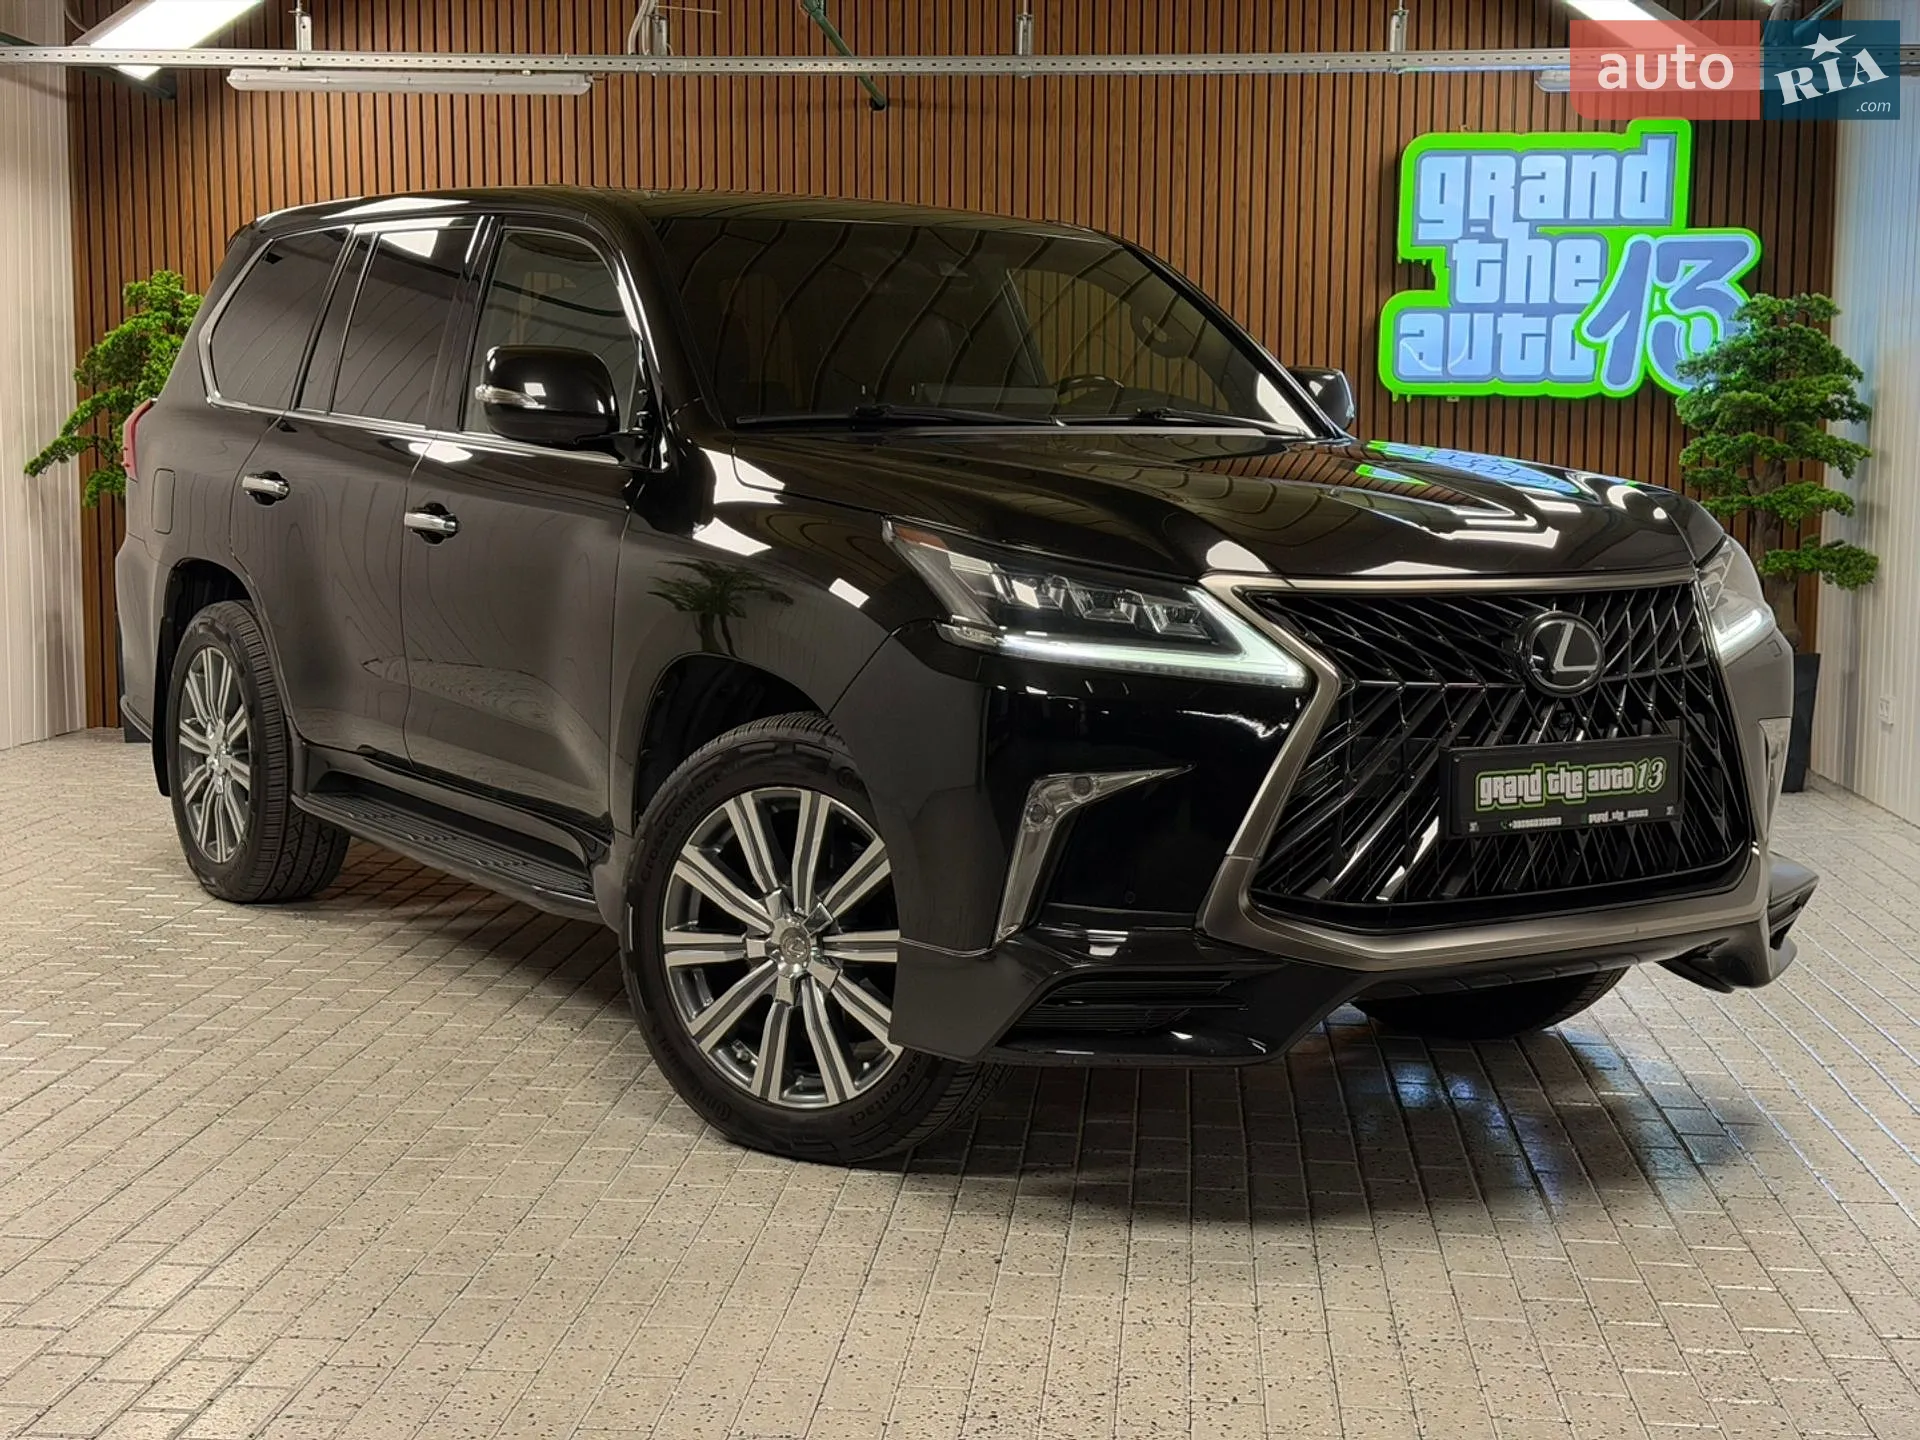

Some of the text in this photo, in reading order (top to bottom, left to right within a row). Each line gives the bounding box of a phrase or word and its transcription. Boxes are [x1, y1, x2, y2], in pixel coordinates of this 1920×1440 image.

[1452, 223, 1602, 304] the
[1397, 313, 1597, 378] auto
[1547, 766, 1584, 799] the
